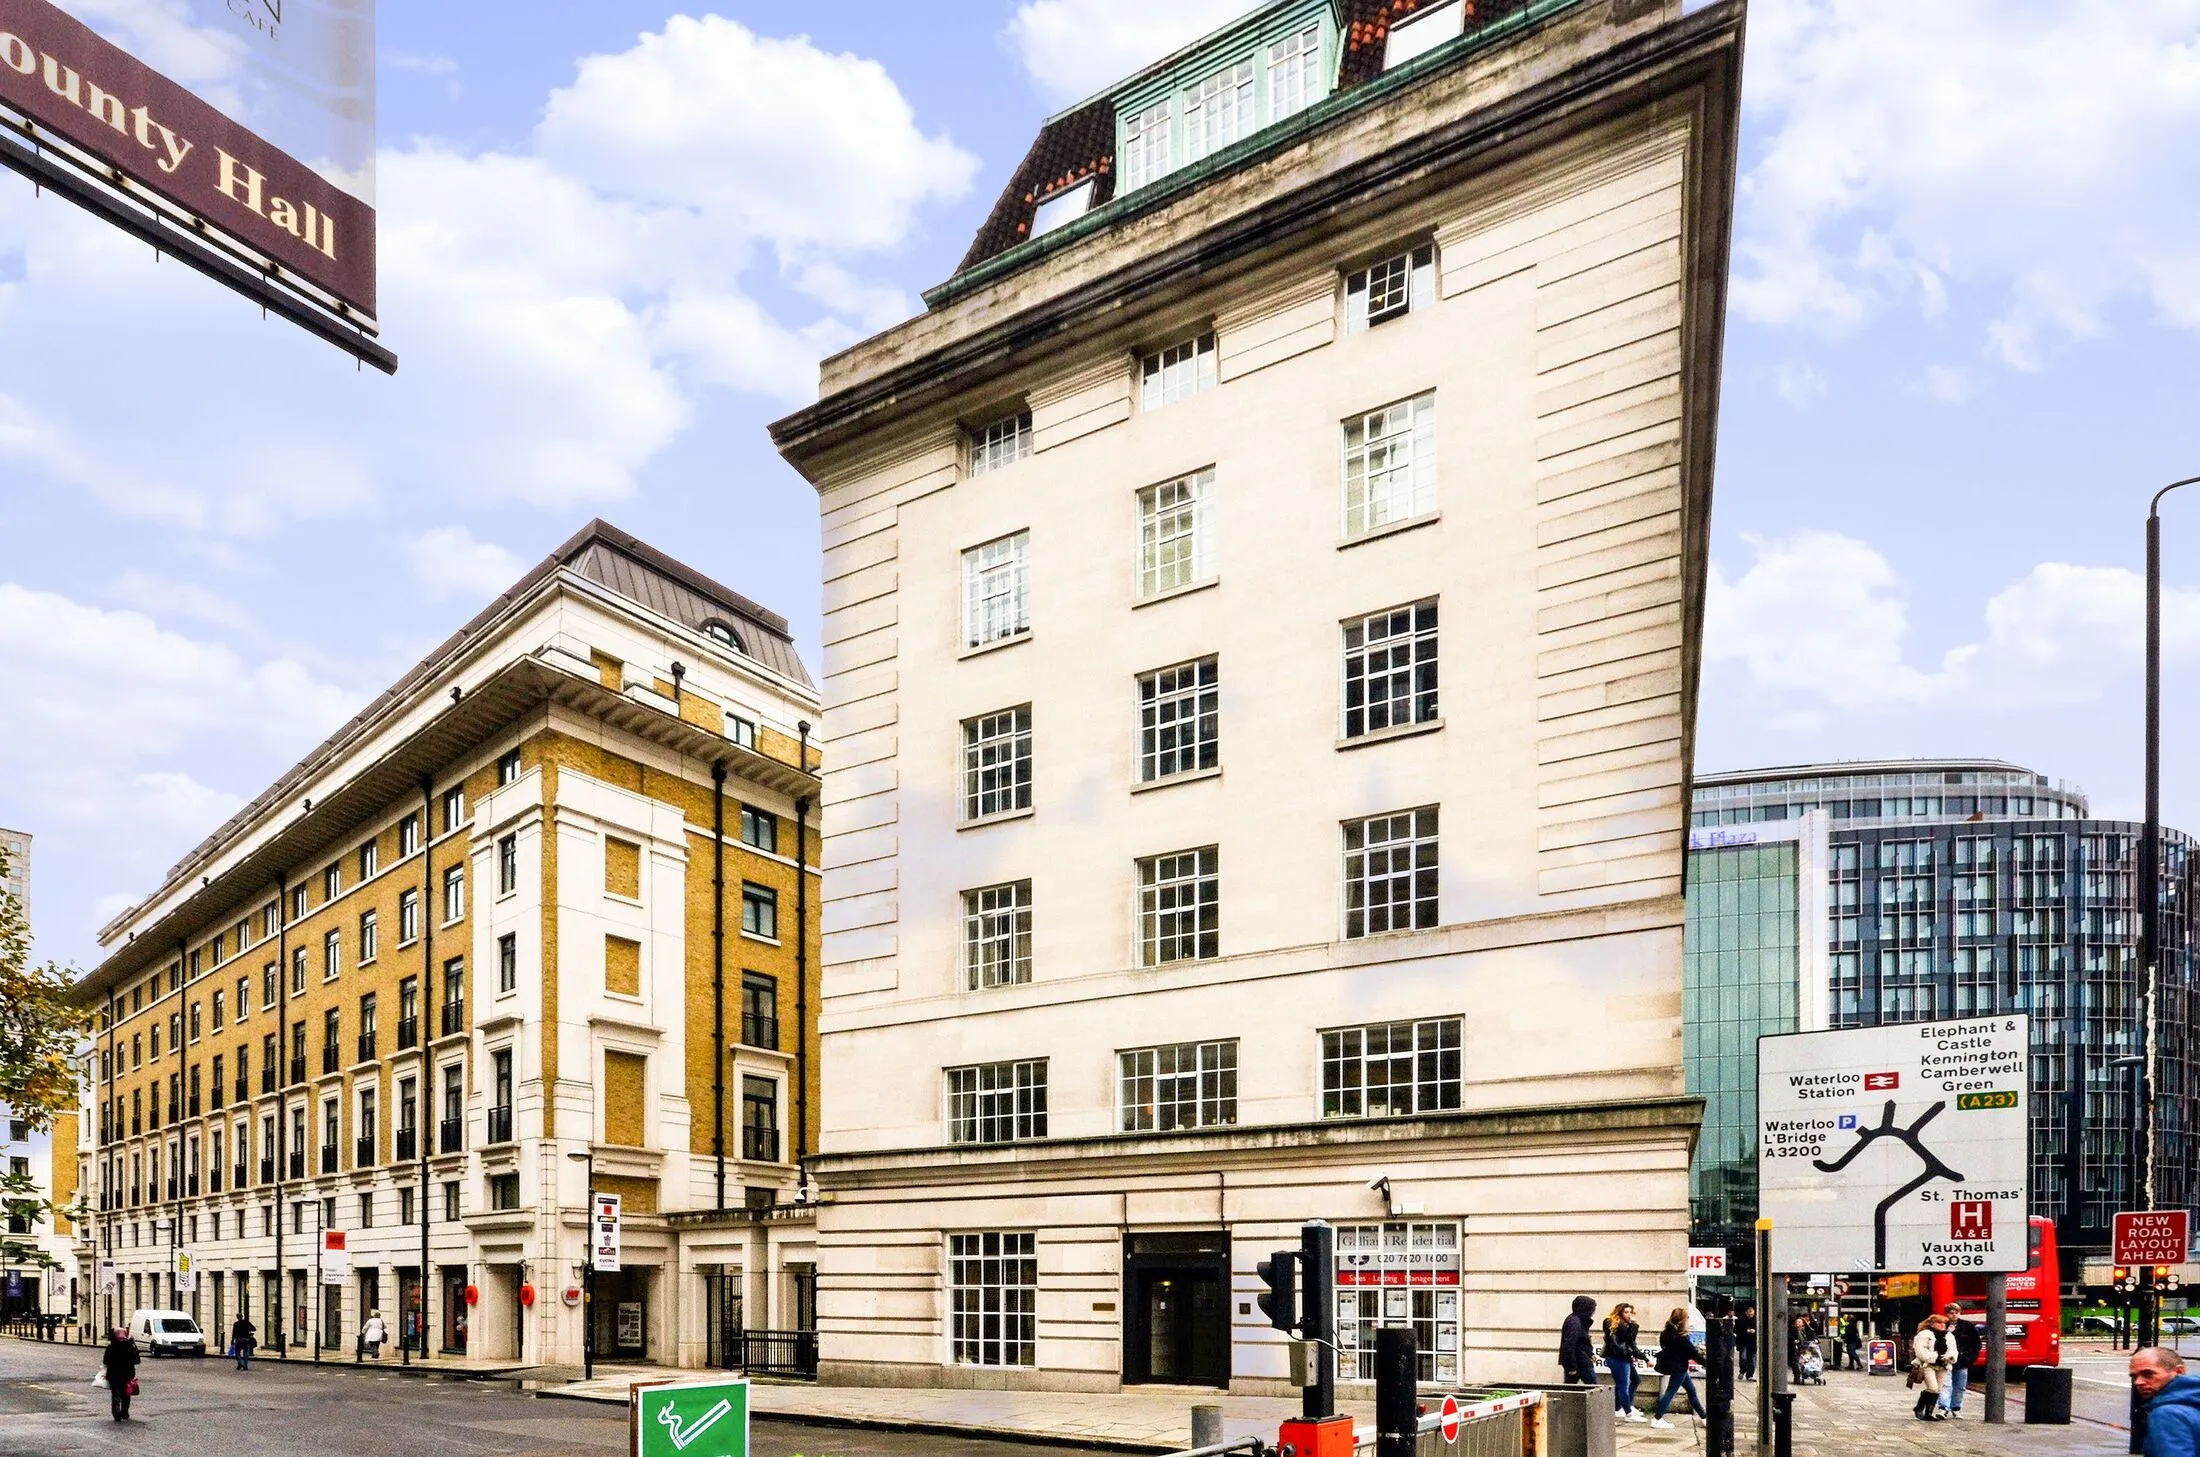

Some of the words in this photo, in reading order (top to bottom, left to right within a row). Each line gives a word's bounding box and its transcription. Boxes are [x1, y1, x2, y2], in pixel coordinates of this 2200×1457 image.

[213, 145, 336, 260] Hall
[1710, 830, 1757, 846] Plaza
[1921, 1022, 1996, 1038] Elephant
[2005, 1021, 2015, 1031] &
[1937, 1037, 1992, 1051] Castle
[1921, 1050, 2018, 1066] Kennington
[1921, 1061, 2024, 1079] Camberwell
[1789, 1073, 1860, 1087] Waterloo
[1942, 1080, 1994, 1092] Green
[1798, 1087, 1855, 1099] Station
[1960, 1092, 2016, 1109] (A23)
[1765, 1119, 1835, 1132] Waterloo
[1842, 1117, 1853, 1128] P
[1921, 1190, 1945, 1202] St.
[1952, 1187, 2023, 1201] Thomas'
[1959, 1203, 1983, 1227] H
[2132, 1216, 2169, 1226] NEW
[1954, 1229, 1963, 1238] A
[1967, 1228, 1976, 1238] &
[1981, 1228, 1989, 1238] E
[2128, 1227, 2173, 1238] ROAD
[1342, 1235, 1388, 1247] Glliad
[1392, 1235, 1456, 1246] Reidetial
[1921, 1241, 1995, 1253] Vauxhall
[2120, 1239, 2181, 1250] LAYOUT
[2121, 1250, 2178, 1261] AHEAD
[1348, 1274, 1366, 1282] Ses
